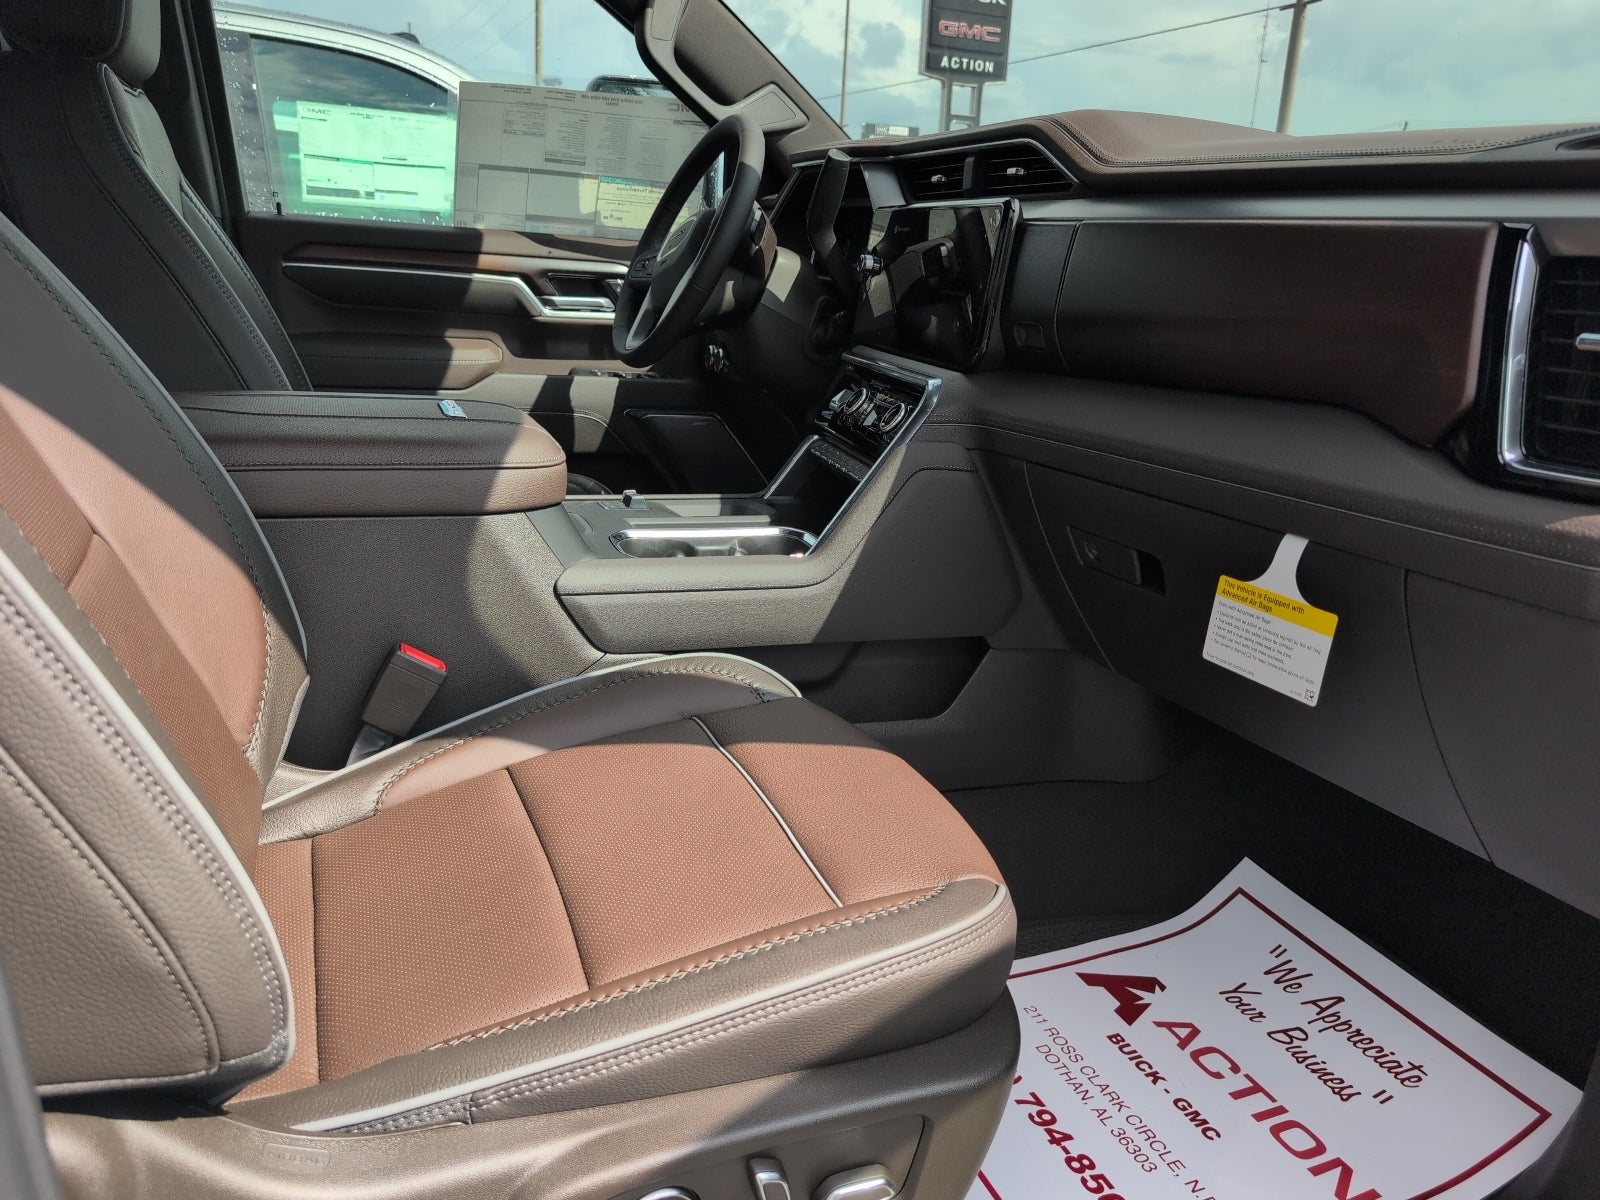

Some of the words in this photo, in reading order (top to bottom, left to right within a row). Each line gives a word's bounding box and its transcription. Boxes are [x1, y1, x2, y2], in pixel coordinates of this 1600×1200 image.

[939, 20, 1001, 42] GMC
[940, 55, 994, 73] ACTION
[1221, 588, 1249, 603] Advanced
[1248, 598, 1258, 607] Air
[1258, 601, 1273, 613] Bags
[1223, 579, 1236, 590] This
[1236, 584, 1257, 597] Vehicle
[1263, 594, 1291, 610] Equipped
[1291, 604, 1305, 615] with
[1218, 981, 1267, 1023] Your
[1266, 1026, 1362, 1103] Business
[1263, 943, 1314, 994] "We
[1300, 995, 1429, 1089] Appreciate
[1023, 1005, 1049, 1025] 211
[1043, 1026, 1084, 1064] ROSS
[1079, 1064, 1132, 1113] CLARK
[1125, 1113, 1187, 1178] CIRCLE,
[1183, 1178, 1216, 1200] N.
[1035, 1043, 1095, 1106] DOTHAN,
[1090, 1106, 1110, 1127] AL
[1110, 1126, 1158, 1174] 36303
[1105, 1032, 1168, 1086] BUICK
[1171, 1097, 1222, 1142] GMC
[1151, 1020, 1383, 1200] ACTION
